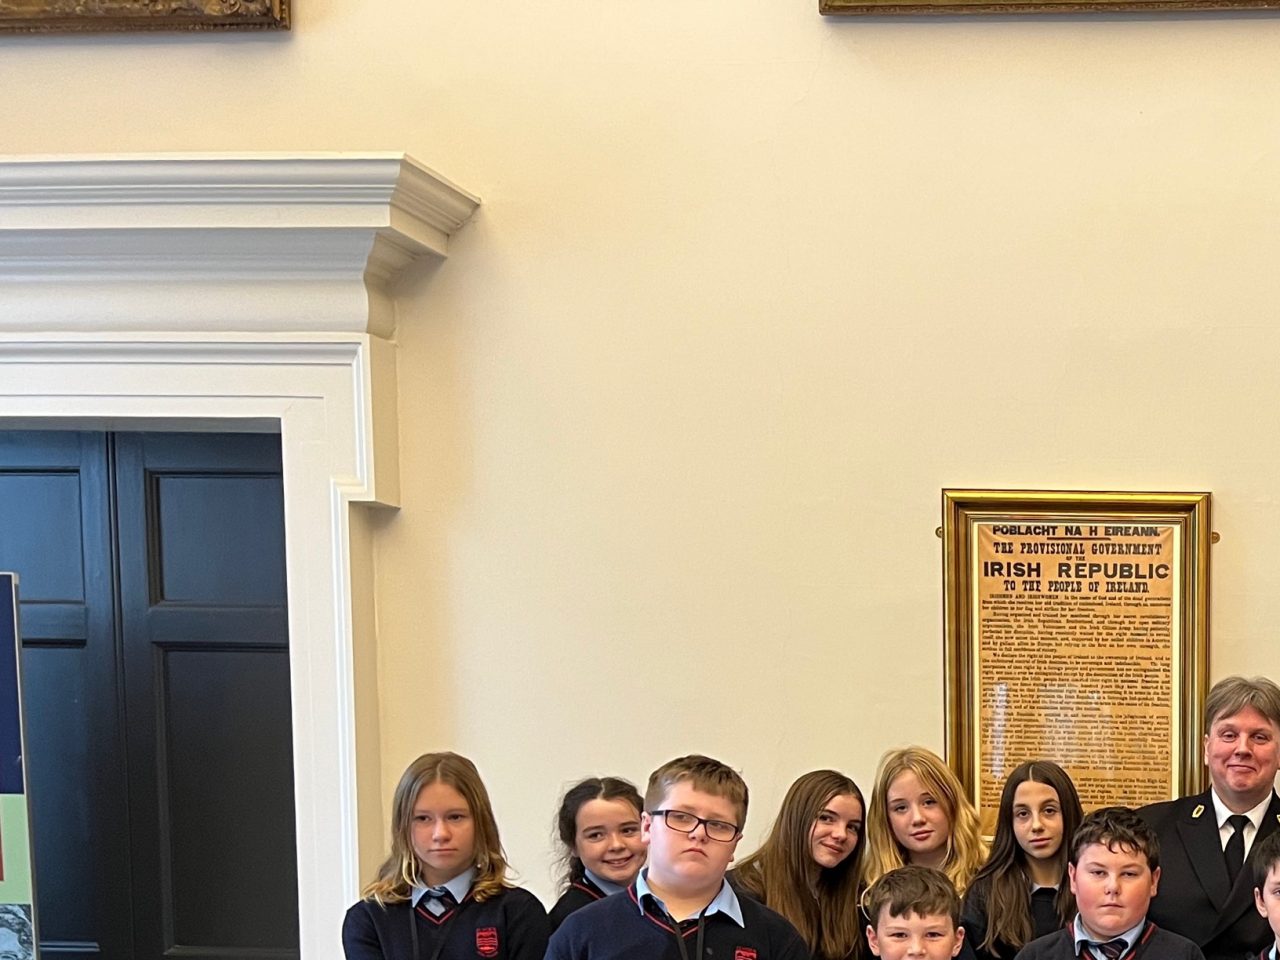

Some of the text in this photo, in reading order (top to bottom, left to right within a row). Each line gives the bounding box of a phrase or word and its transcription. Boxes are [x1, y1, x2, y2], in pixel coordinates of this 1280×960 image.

[993, 526, 1058, 536] POBLACHT
[1065, 526, 1082, 536] NA
[1089, 526, 1098, 536] H
[993, 542, 1162, 555] THE PROVISIONAL GOVERNMENT
[984, 562, 1170, 579] IRISH REPUBLIC
[1004, 580, 1150, 593] TO THE PEOPLE OF IRELAND.
